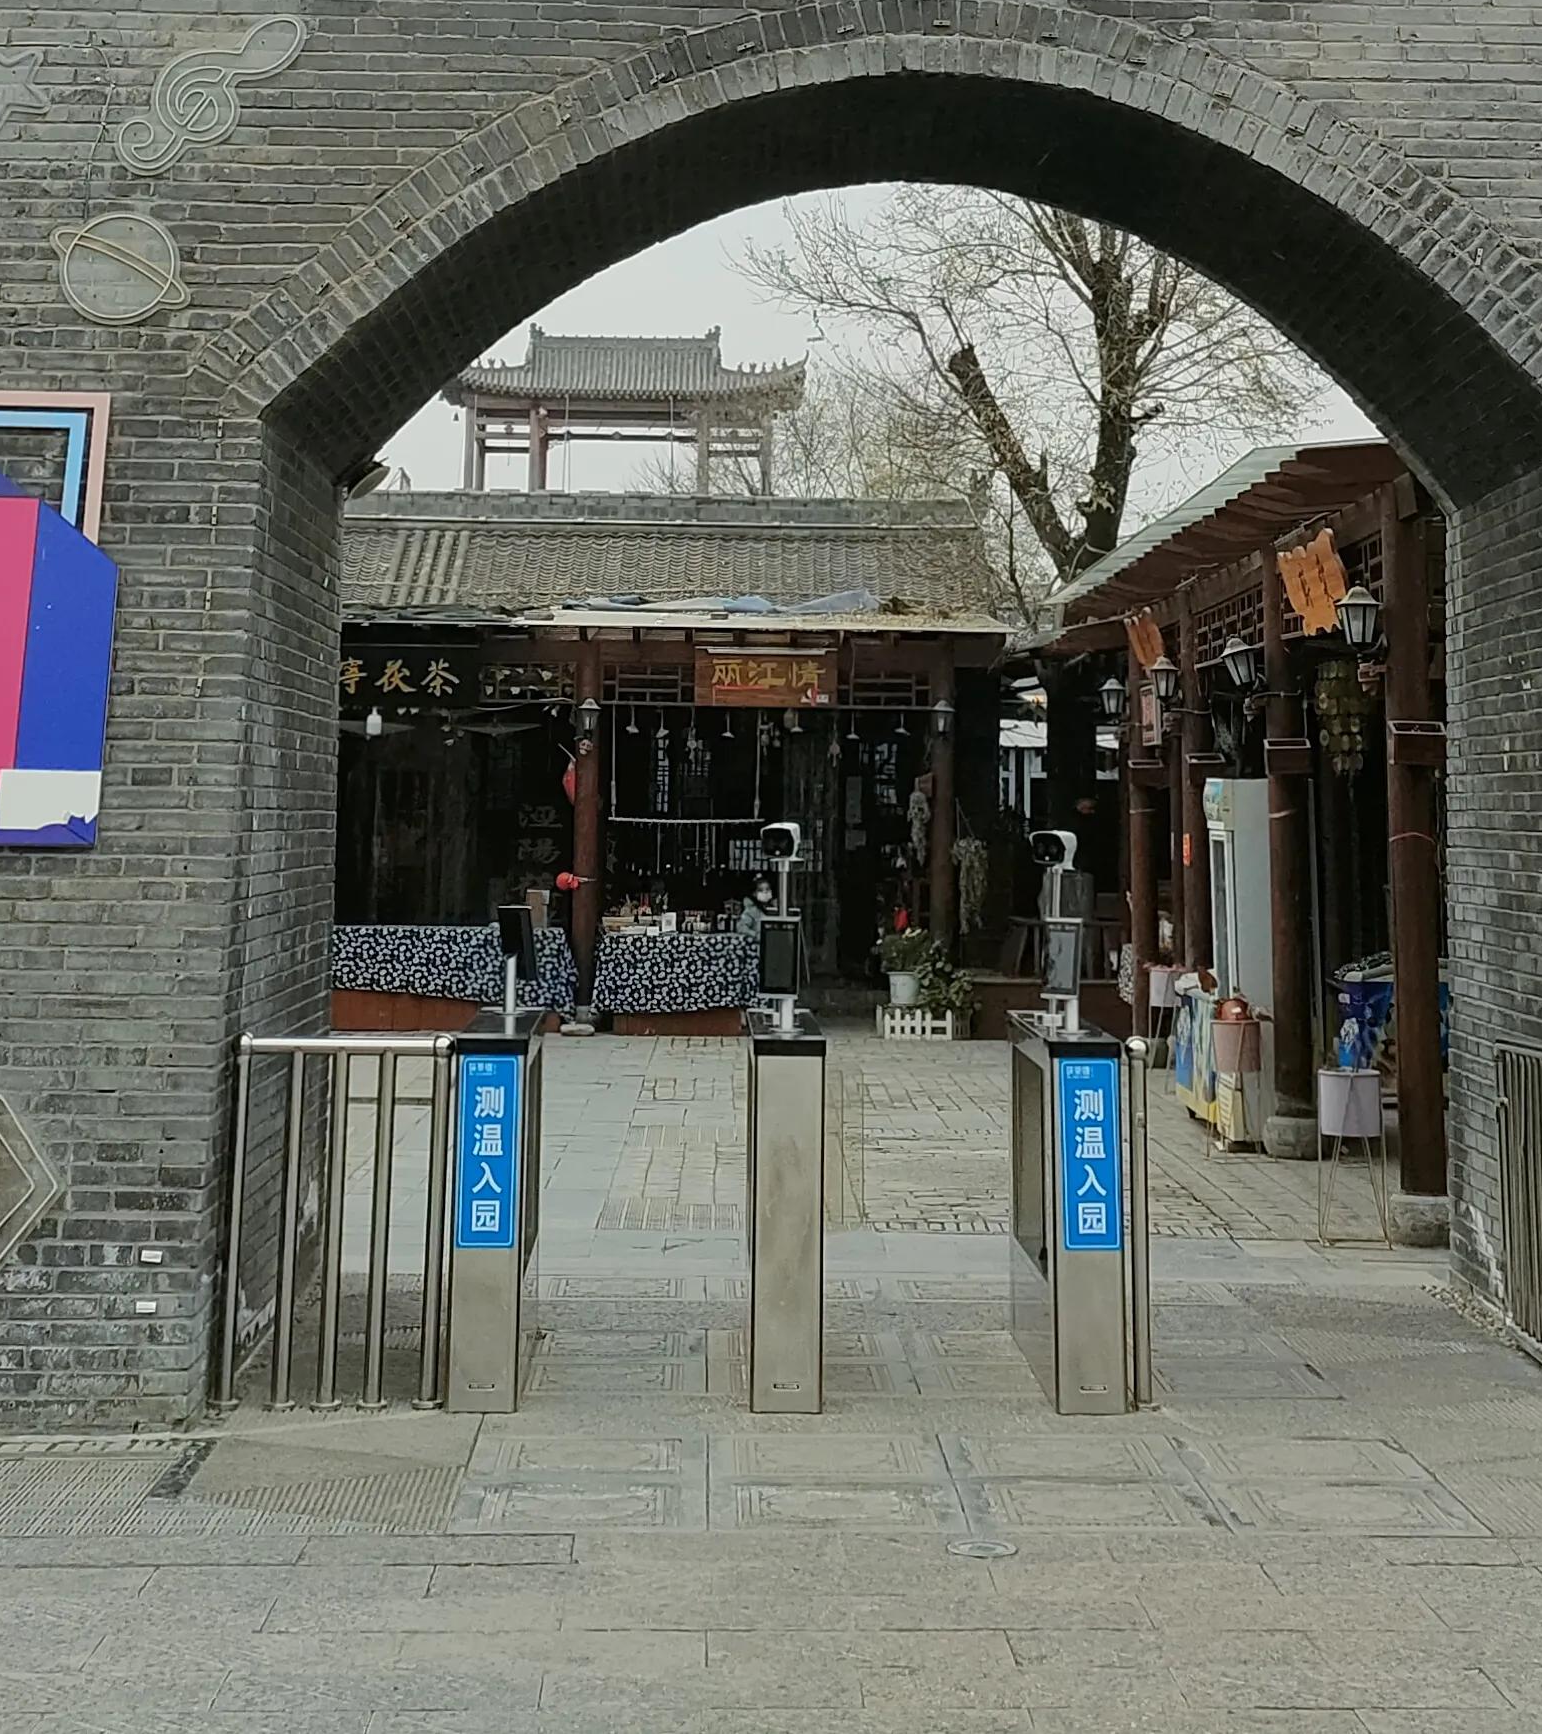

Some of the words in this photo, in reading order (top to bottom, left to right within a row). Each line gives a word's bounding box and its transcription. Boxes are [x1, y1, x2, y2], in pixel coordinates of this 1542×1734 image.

[711, 658, 826, 689] 丽江情
[471, 1085, 505, 1233] 测温入园
[1074, 1088, 1108, 1235] 测温入园
